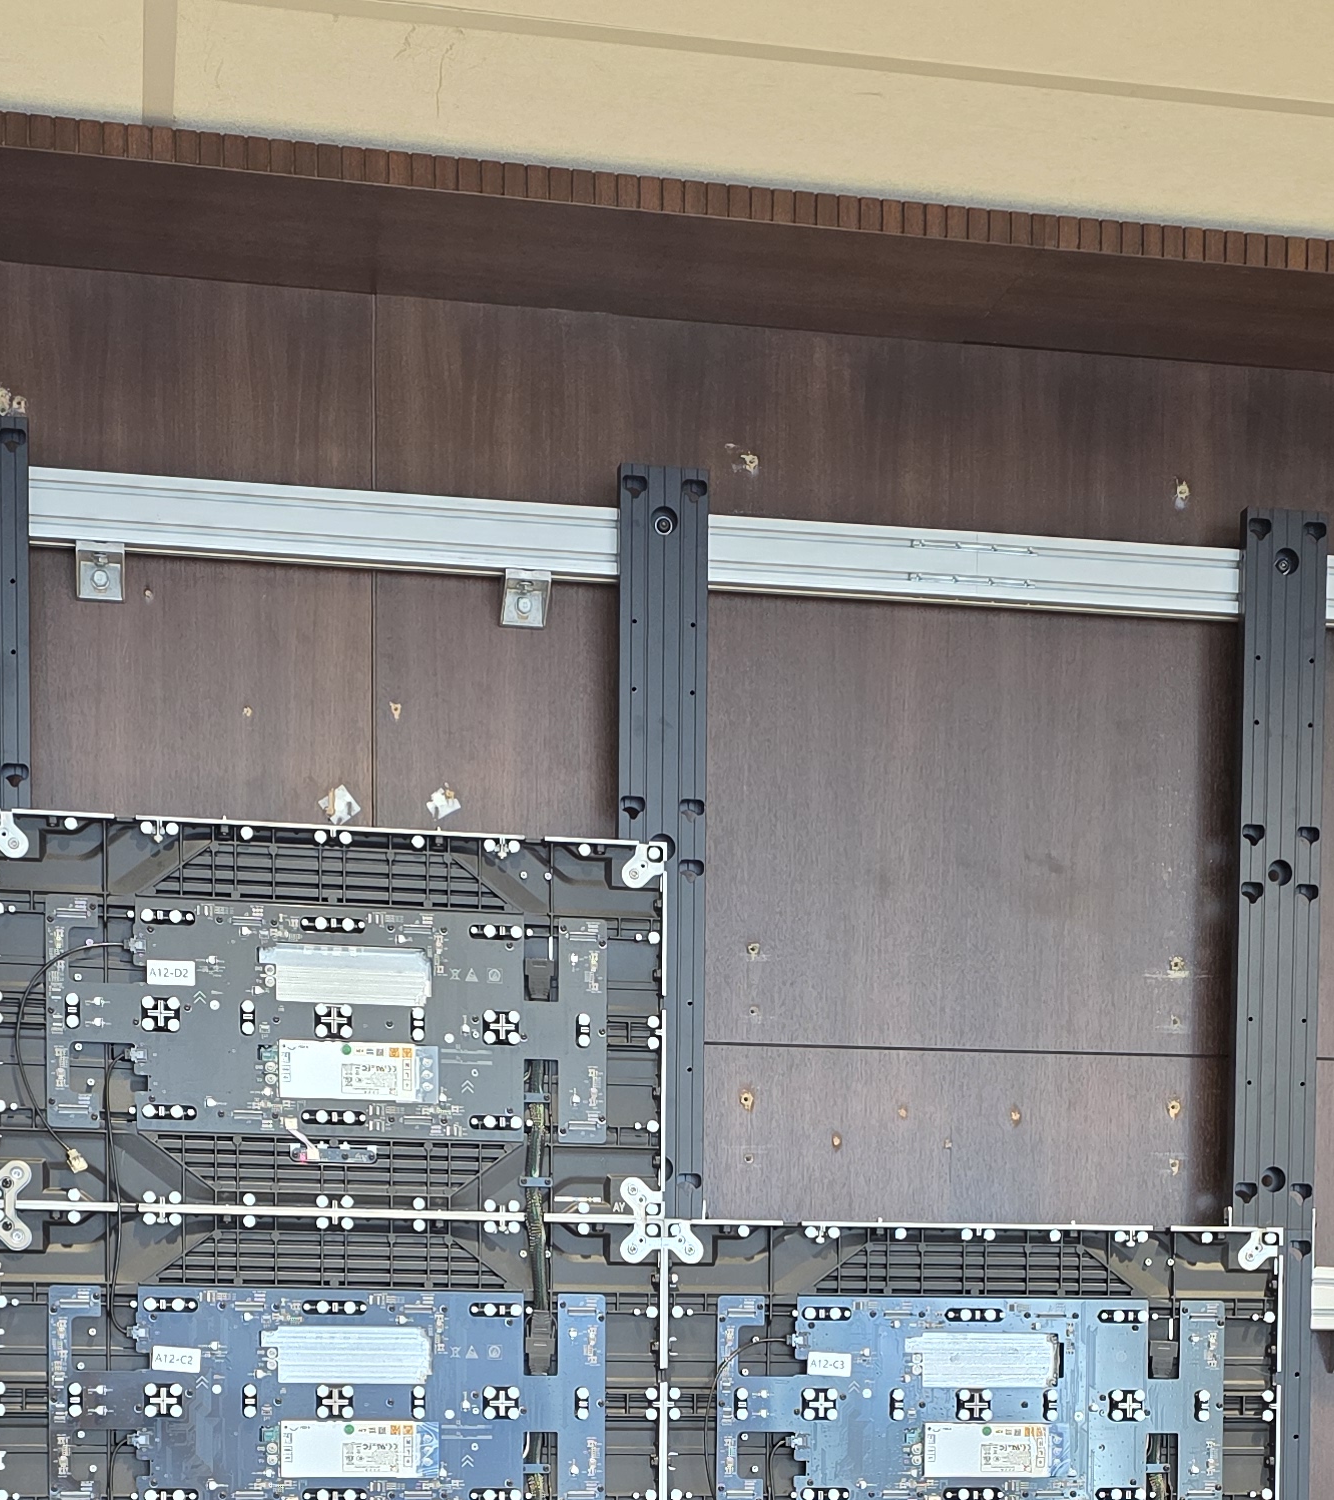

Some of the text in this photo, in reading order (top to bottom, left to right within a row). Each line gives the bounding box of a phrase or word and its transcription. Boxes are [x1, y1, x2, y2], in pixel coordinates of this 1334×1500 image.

[149, 967, 189, 979] A12-D2
[612, 1202, 626, 1212] AY
[154, 1353, 194, 1366] A12-C2
[810, 1359, 845, 1370] A12-C3
